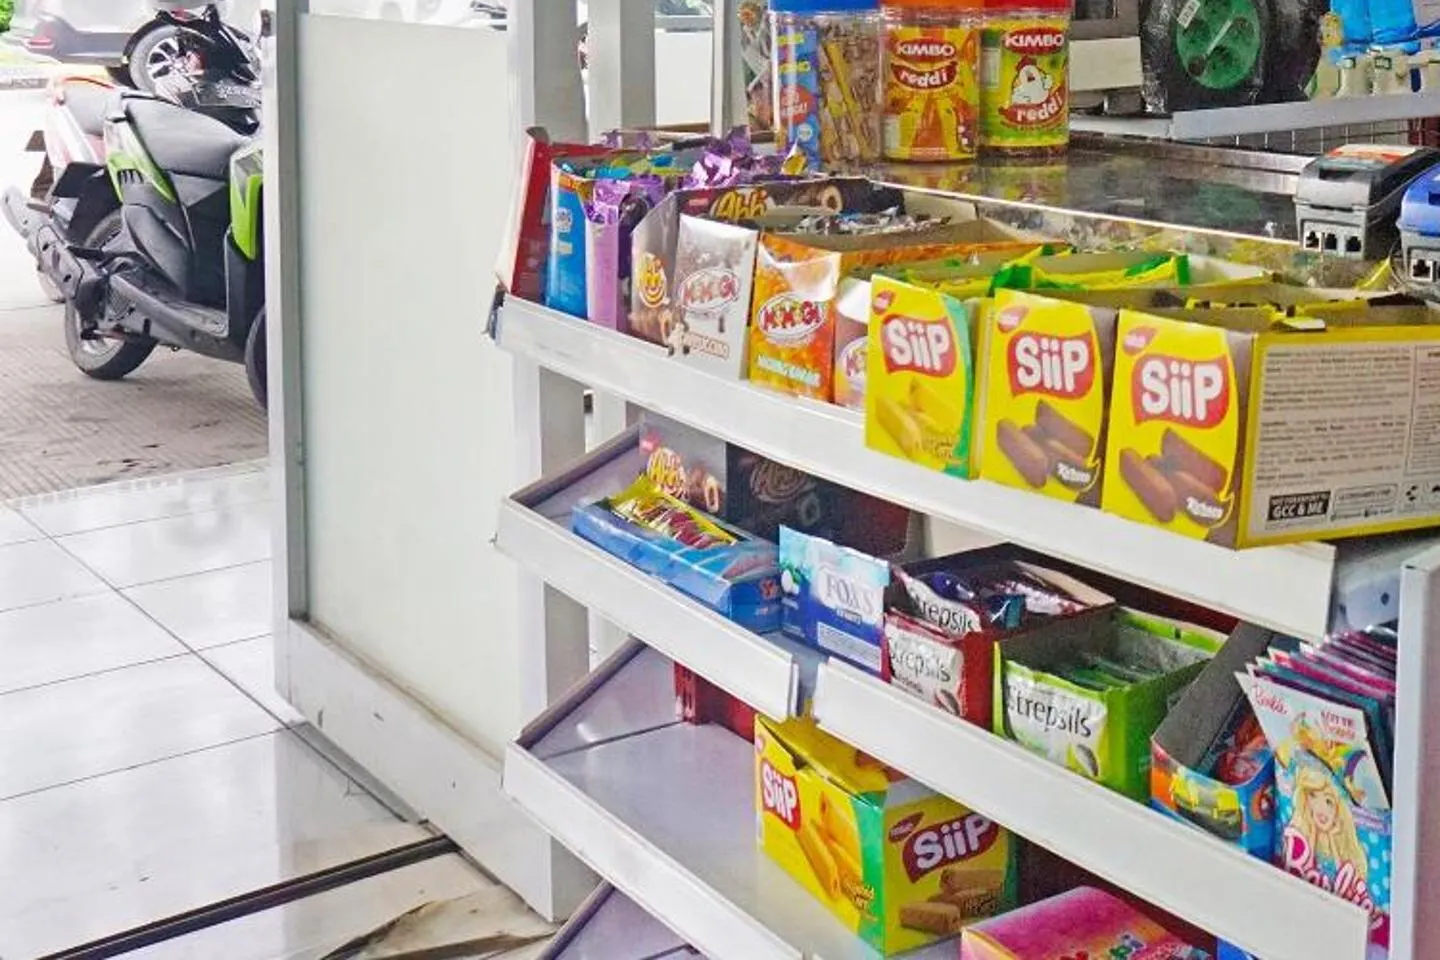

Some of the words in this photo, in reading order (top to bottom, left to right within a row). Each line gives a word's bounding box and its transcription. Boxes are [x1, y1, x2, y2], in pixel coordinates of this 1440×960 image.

[896, 42, 956, 58] KIMBO
[1005, 31, 1066, 50] KIMBO
[886, 318, 951, 373] SiiP
[1015, 335, 1090, 392] SiiP
[1141, 358, 1225, 420] SiiP
[763, 762, 797, 823] SiiP
[913, 813, 993, 870] SiiP
